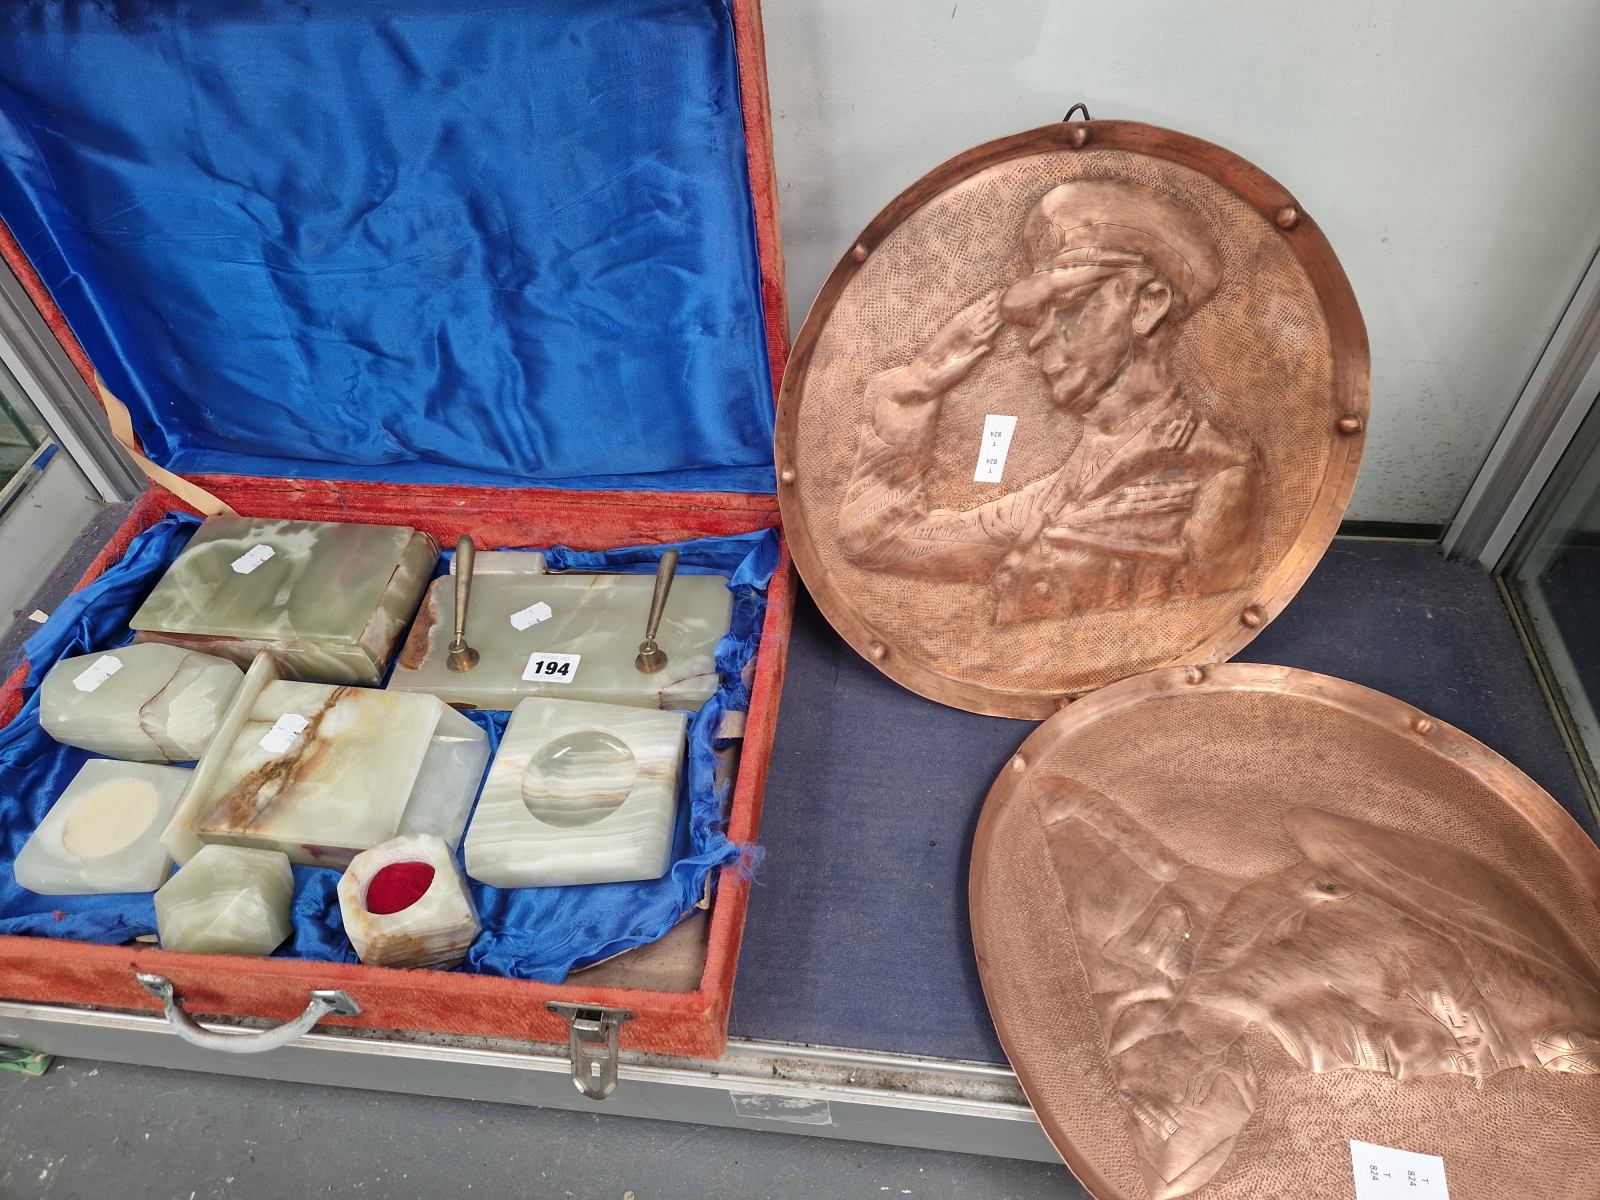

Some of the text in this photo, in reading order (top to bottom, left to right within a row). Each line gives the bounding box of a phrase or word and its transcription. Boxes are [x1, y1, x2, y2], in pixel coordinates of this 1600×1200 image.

[534, 660, 570, 676] 194
[1370, 1164, 1379, 1181] 824
[1408, 1170, 1417, 1186] 824
